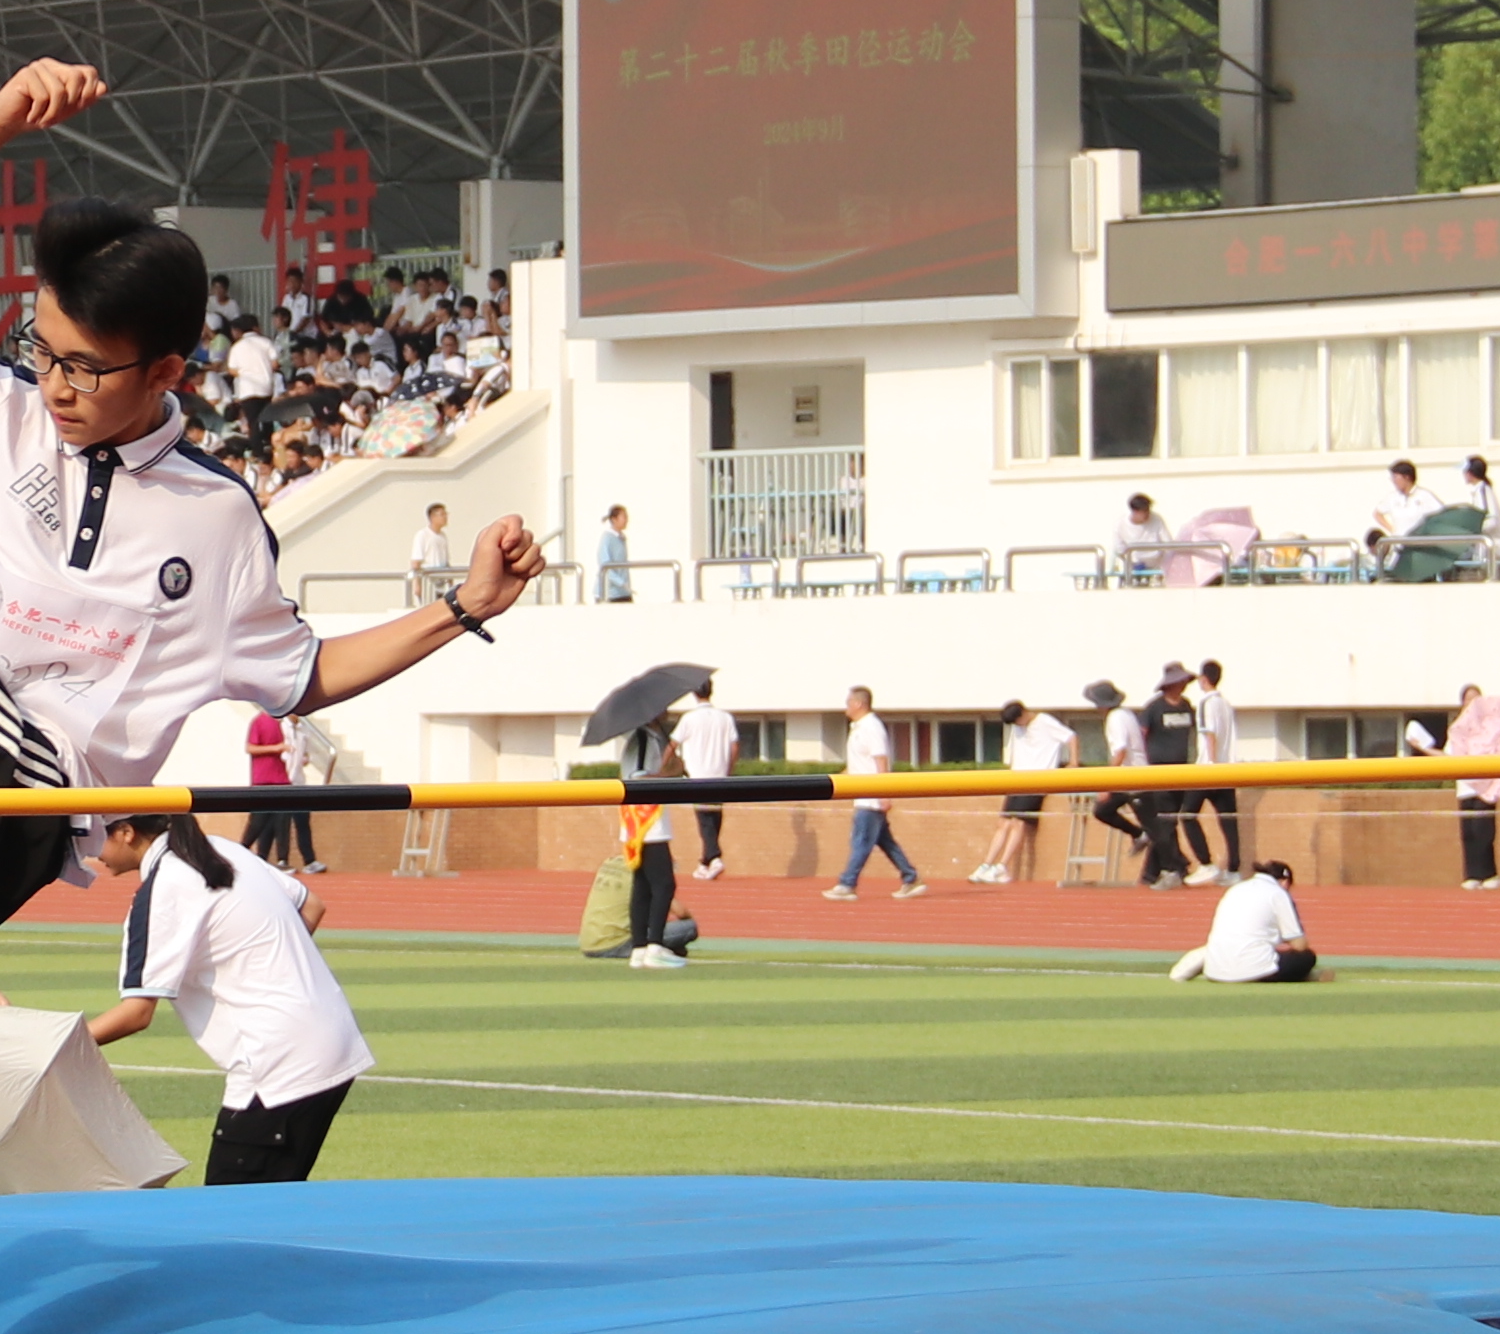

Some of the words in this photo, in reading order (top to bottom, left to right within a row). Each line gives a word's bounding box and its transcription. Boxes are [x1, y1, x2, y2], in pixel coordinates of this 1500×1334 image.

[618, 19, 977, 89] 第二十二届秋季田径运动会
[1, 617, 33, 635] HEFEI
[37, 630, 54, 644] 168
[58, 636, 87, 652] HIGH
[89, 645, 128, 663] SCHOOL
[6, 600, 138, 651] 合肥一六八中学
